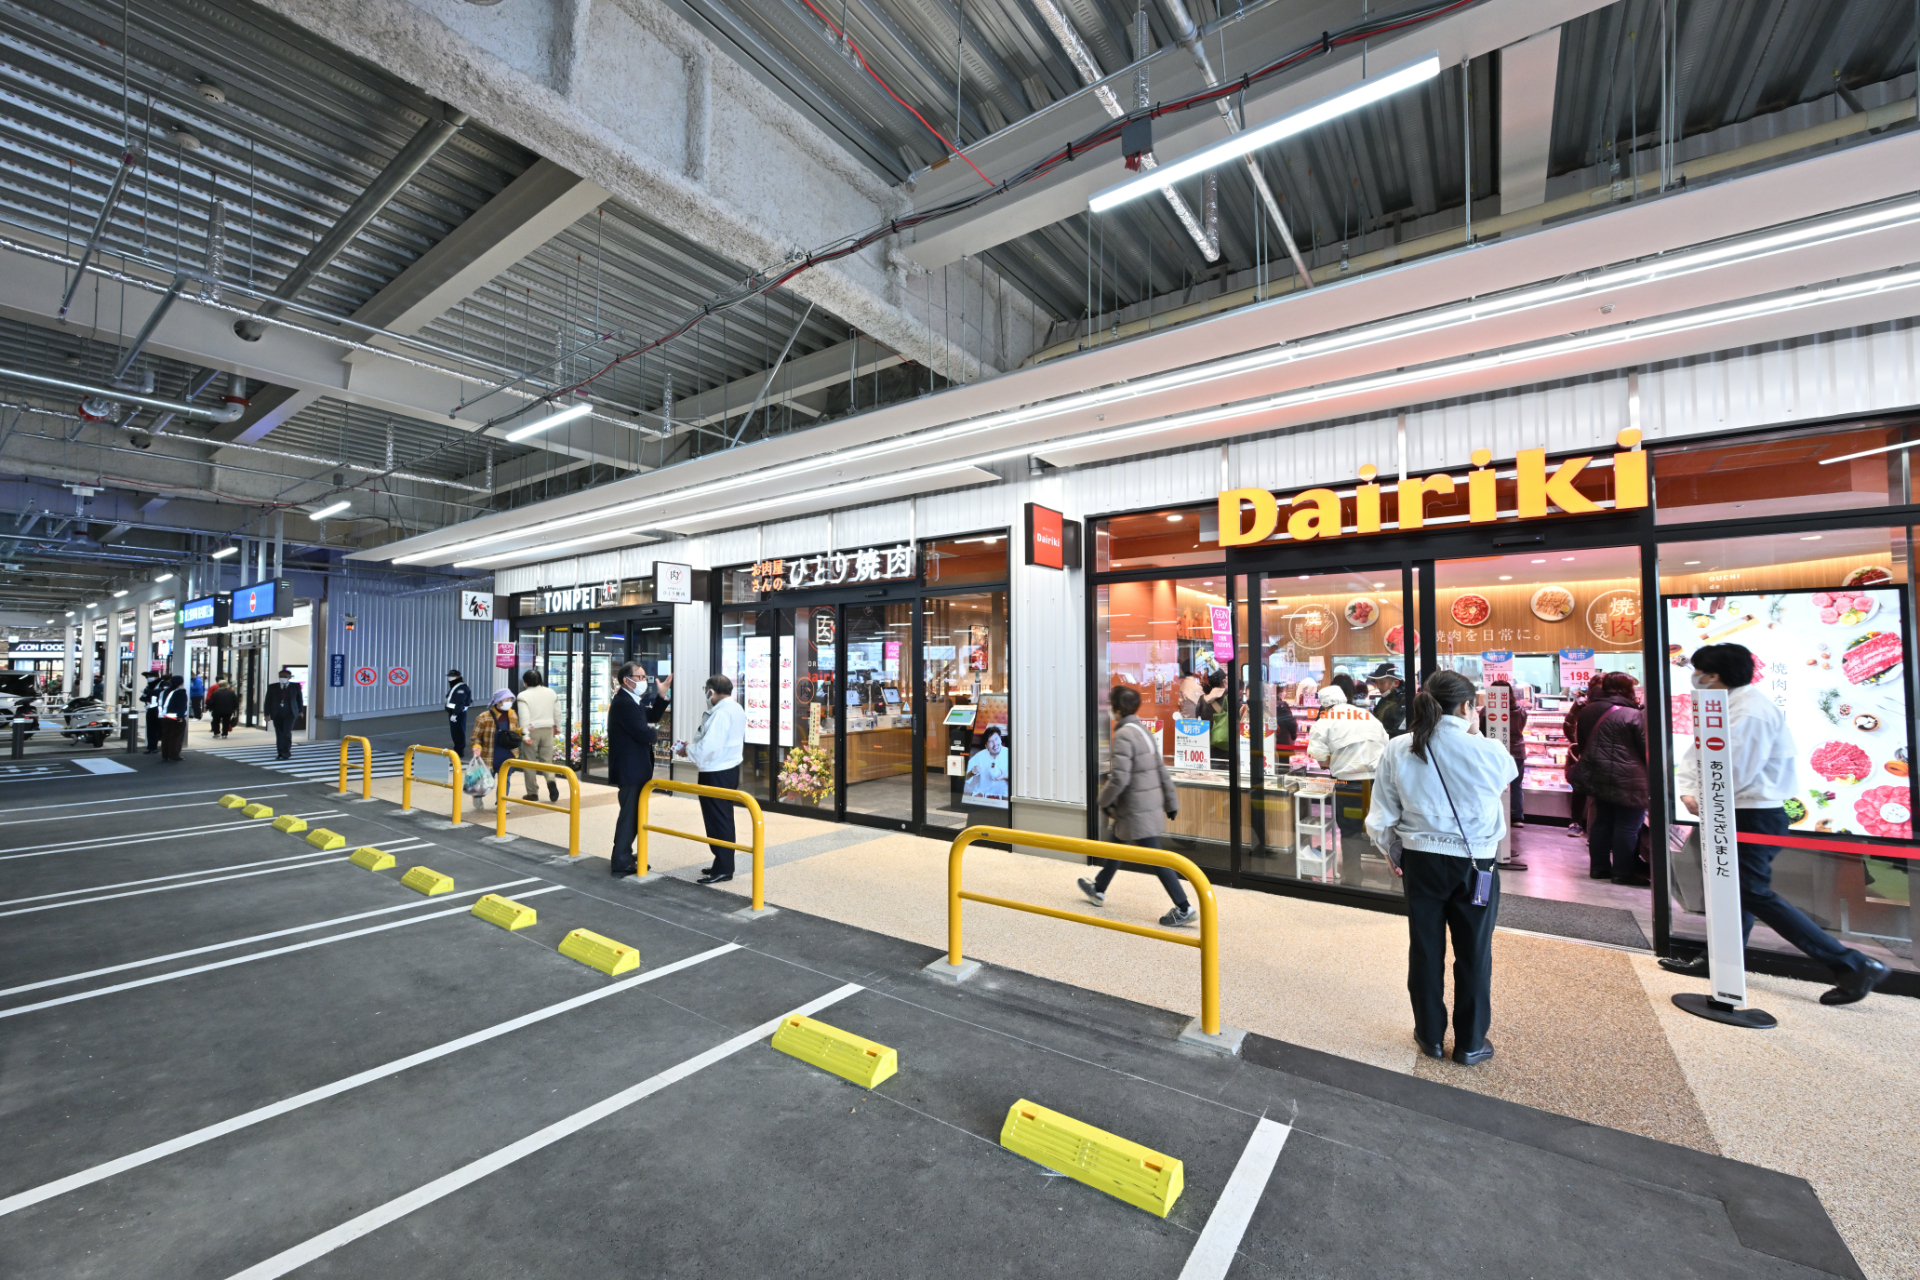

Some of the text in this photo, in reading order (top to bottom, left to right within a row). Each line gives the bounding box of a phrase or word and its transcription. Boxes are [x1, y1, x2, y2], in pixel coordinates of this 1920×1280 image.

[1218, 427, 1648, 547] Dairiki
[1037, 532, 1060, 547] Dairiki
[751, 559, 783, 576] お肉屋
[789, 545, 911, 586] ひとり焼肉
[751, 577, 783, 592] さんの
[1709, 573, 1740, 581] OUCHI
[544, 587, 596, 613] TONPEI
[1570, 671, 1590, 681] 198
[1770, 662, 1787, 721] 焼肉を
[1488, 692, 1496, 708] 出口
[1501, 692, 1508, 709] 出口
[1307, 708, 1370, 720] Dairiki
[1183, 724, 1201, 734] 朝市
[1705, 699, 1730, 878] 出口 ありがとうございました
